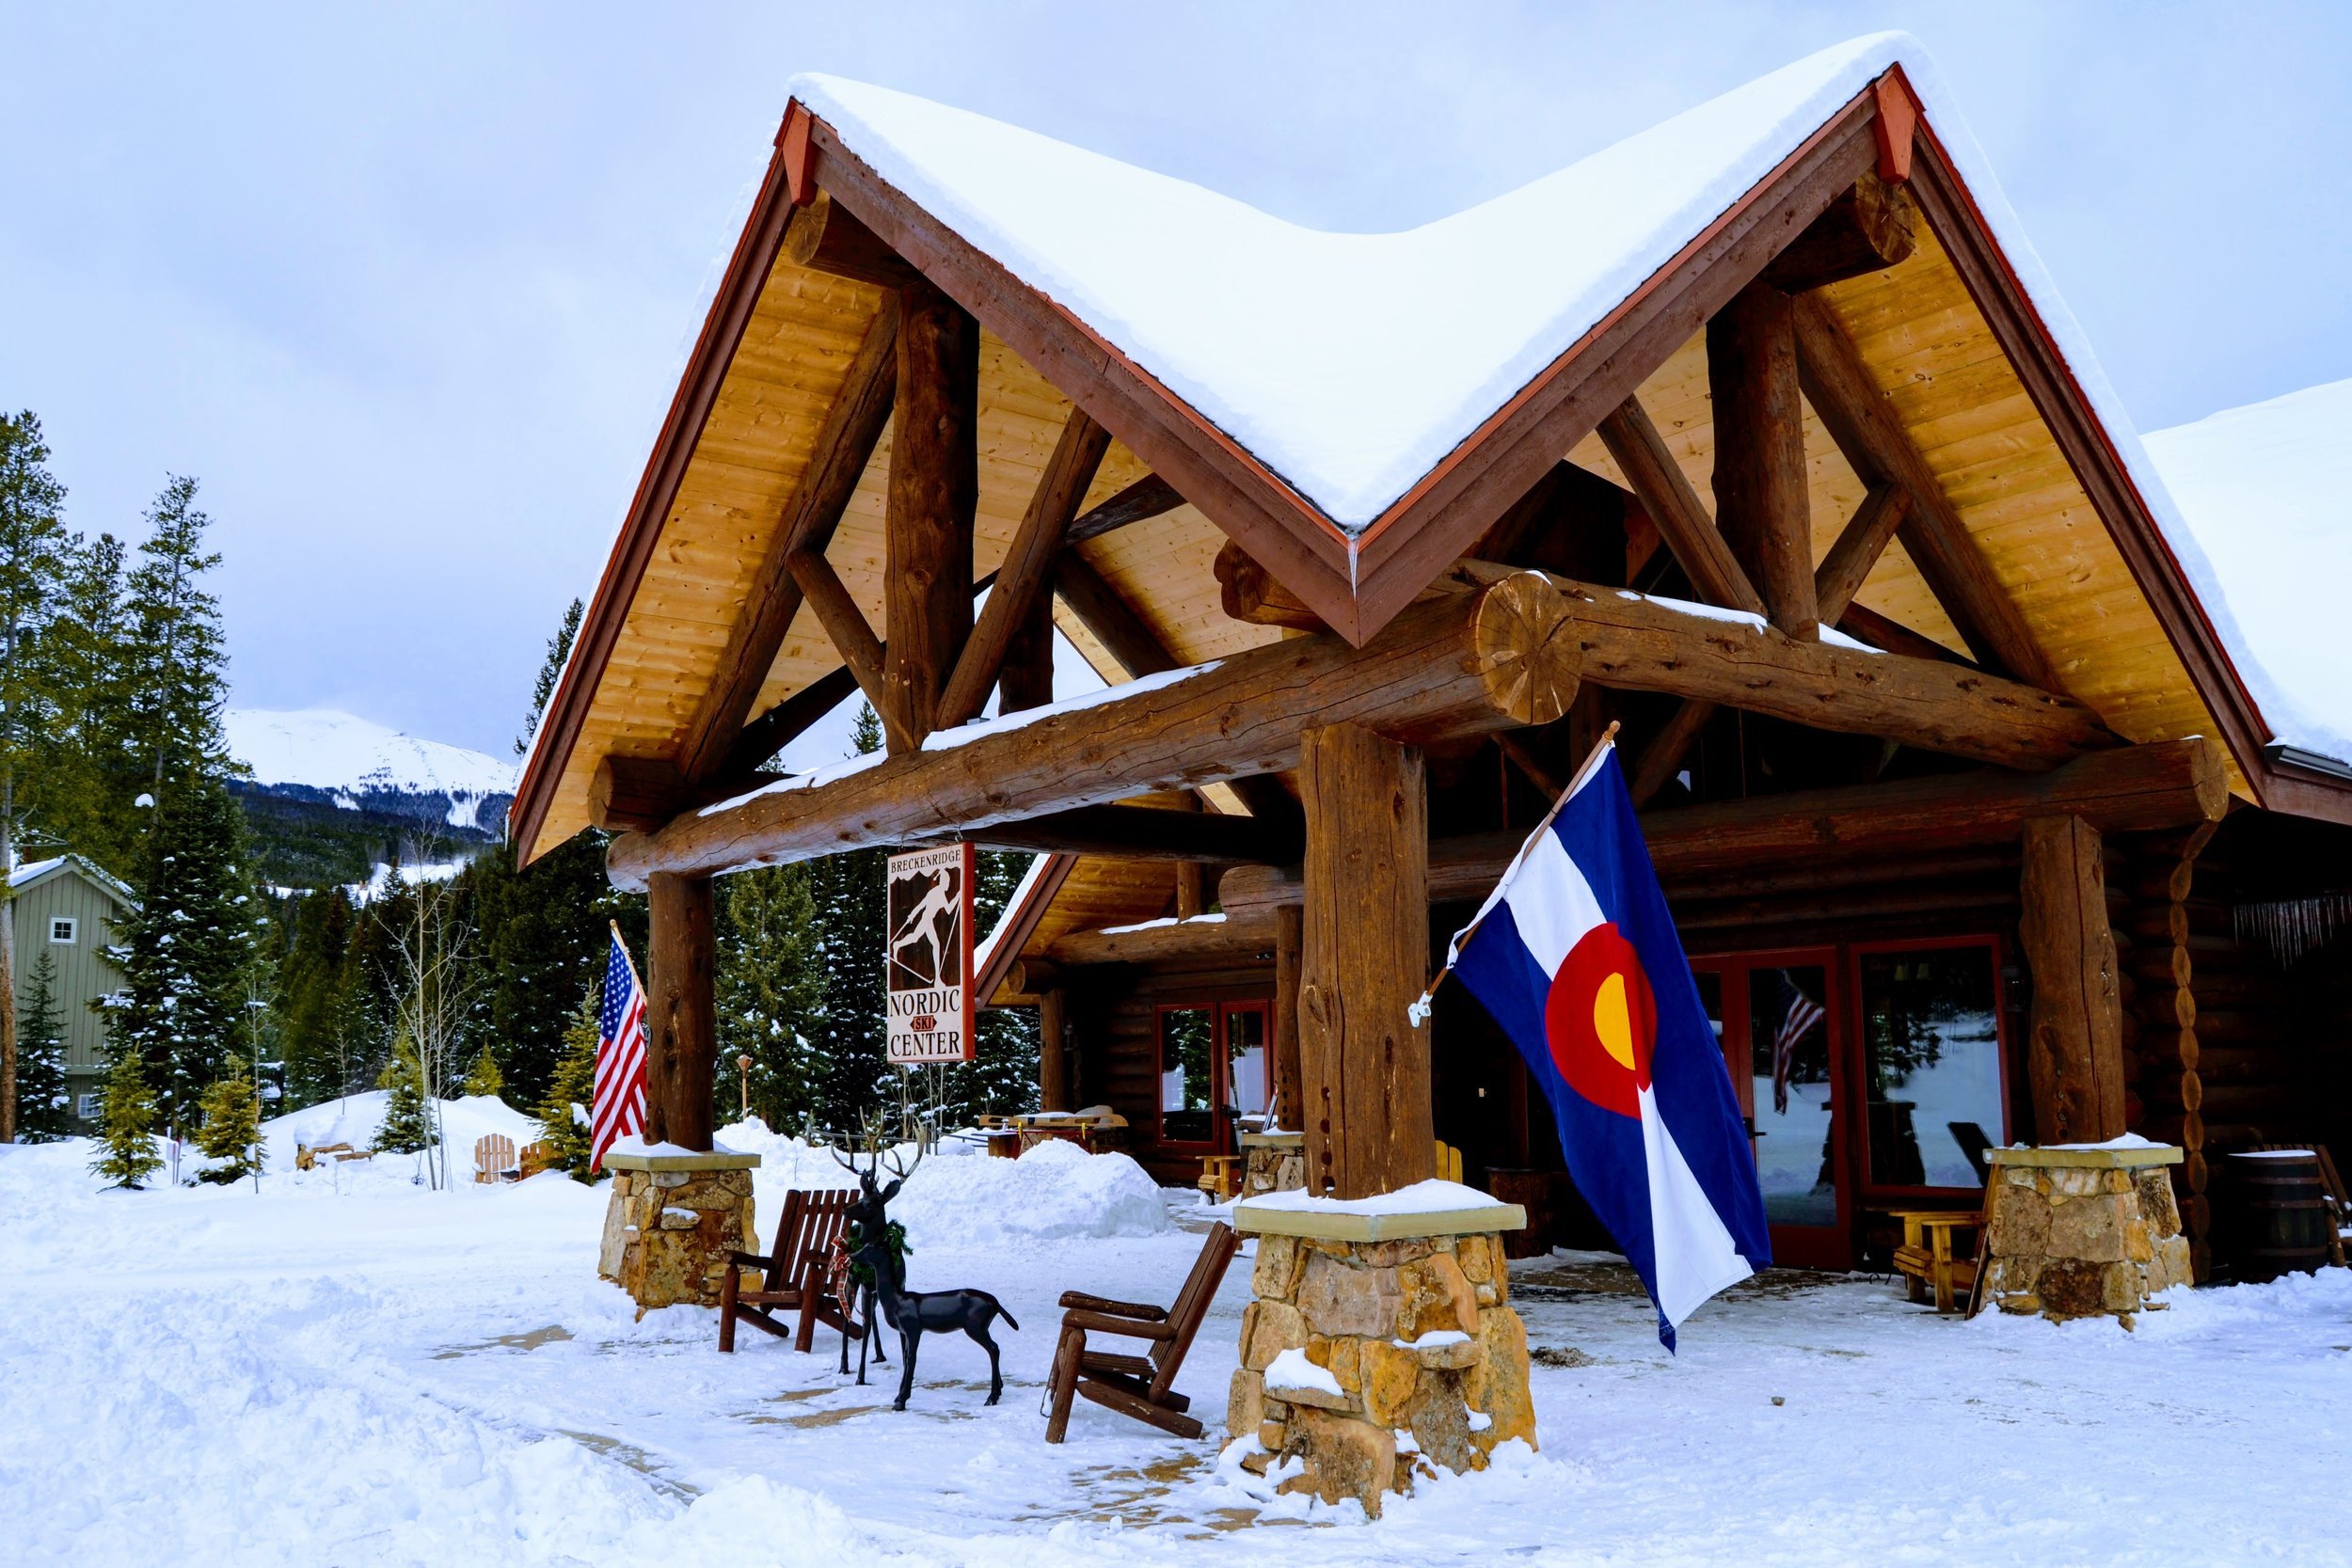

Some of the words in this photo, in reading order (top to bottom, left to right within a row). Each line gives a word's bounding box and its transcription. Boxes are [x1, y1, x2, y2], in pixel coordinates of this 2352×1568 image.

[891, 849, 961, 873] BRECKENRIDGE
[890, 989, 960, 1017] NORDIC
[914, 1016, 932, 1030] SKI
[890, 1031, 960, 1056] CENTER
